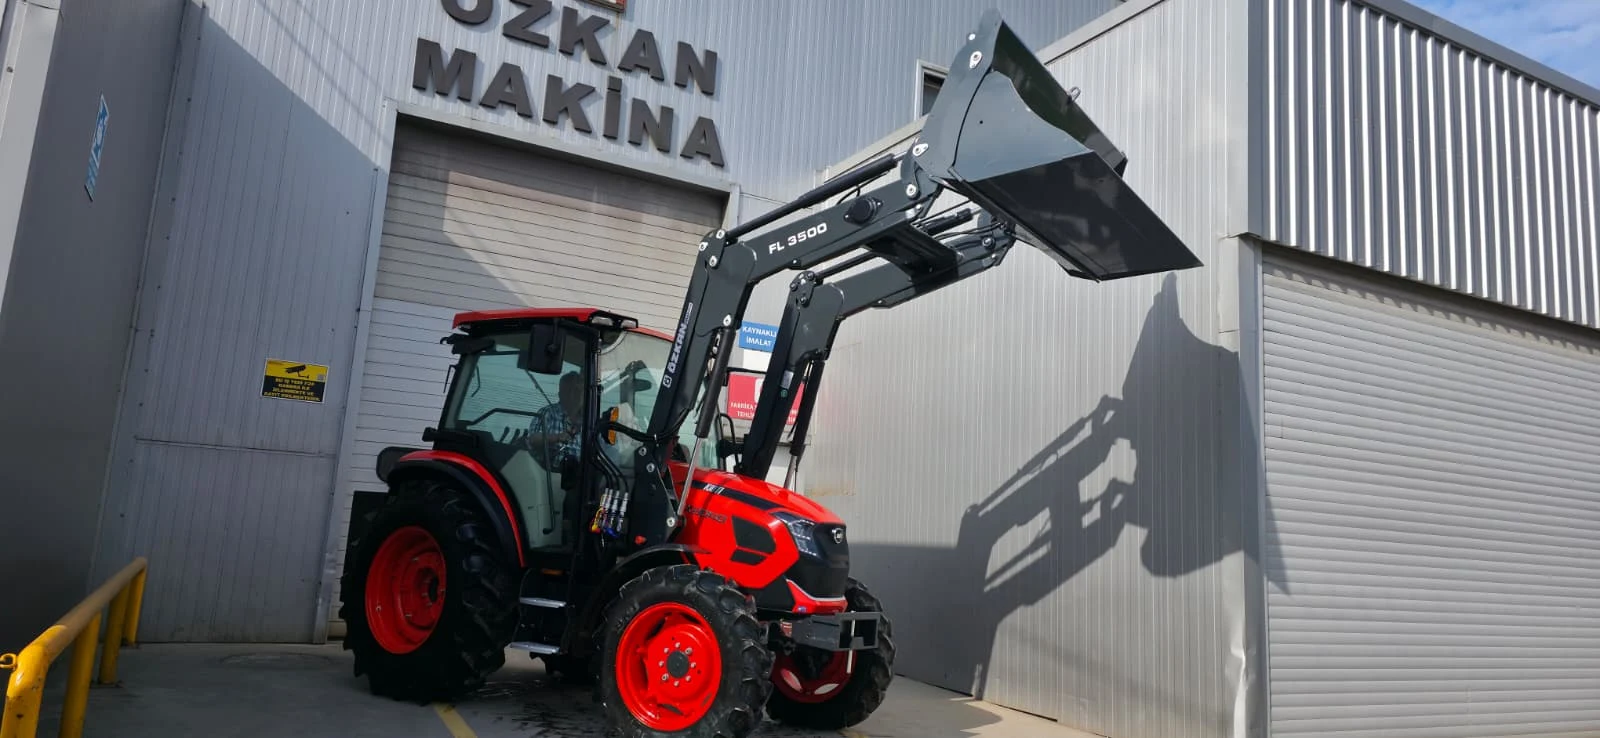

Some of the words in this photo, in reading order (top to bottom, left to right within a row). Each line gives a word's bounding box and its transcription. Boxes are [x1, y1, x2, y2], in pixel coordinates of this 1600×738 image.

[412, 37, 725, 168] MAKİNA
[768, 241, 785, 254] FL
[787, 222, 828, 246] 3500
[742, 326, 777, 338] KAYNAKLI
[746, 336, 772, 347] İMALAT
